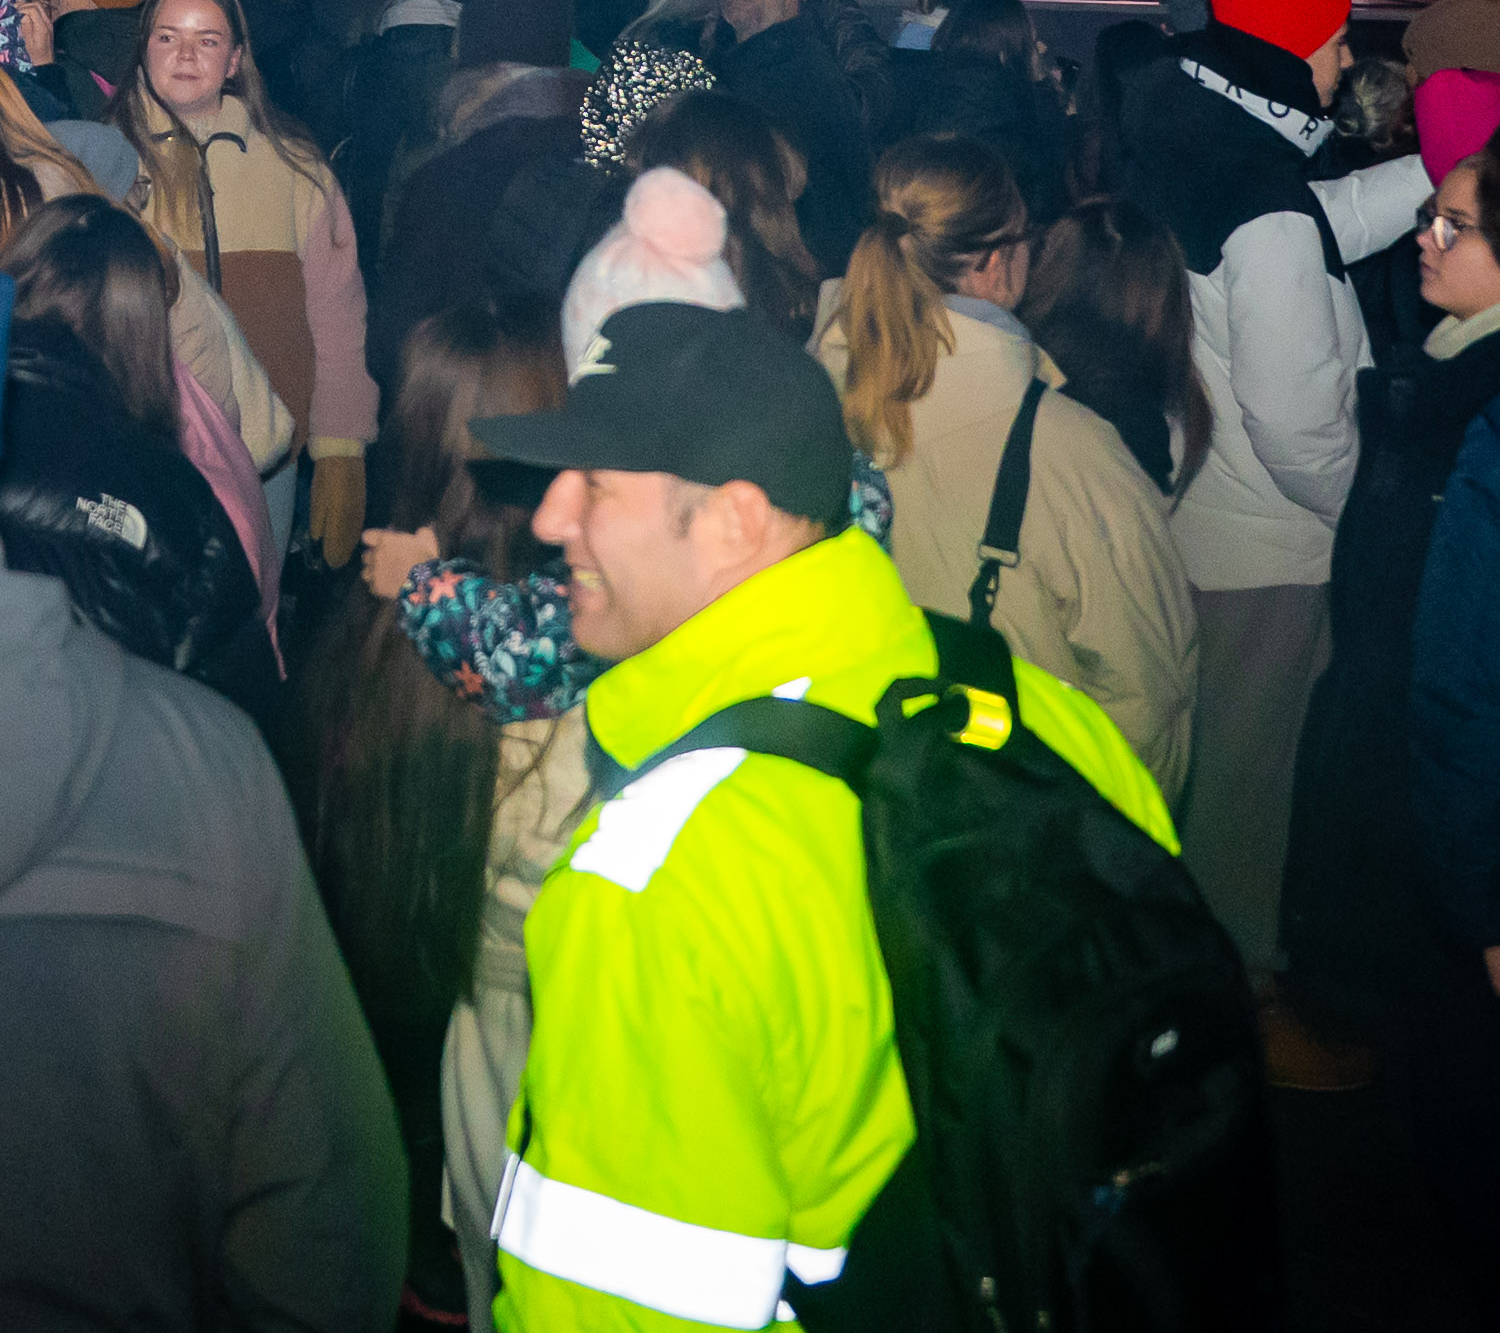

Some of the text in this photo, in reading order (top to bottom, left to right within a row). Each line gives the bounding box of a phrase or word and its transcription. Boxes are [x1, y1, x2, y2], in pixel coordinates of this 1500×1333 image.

[75, 497, 125, 523] NORTH
[101, 493, 127, 510] THE
[87, 512, 123, 534] FACE
